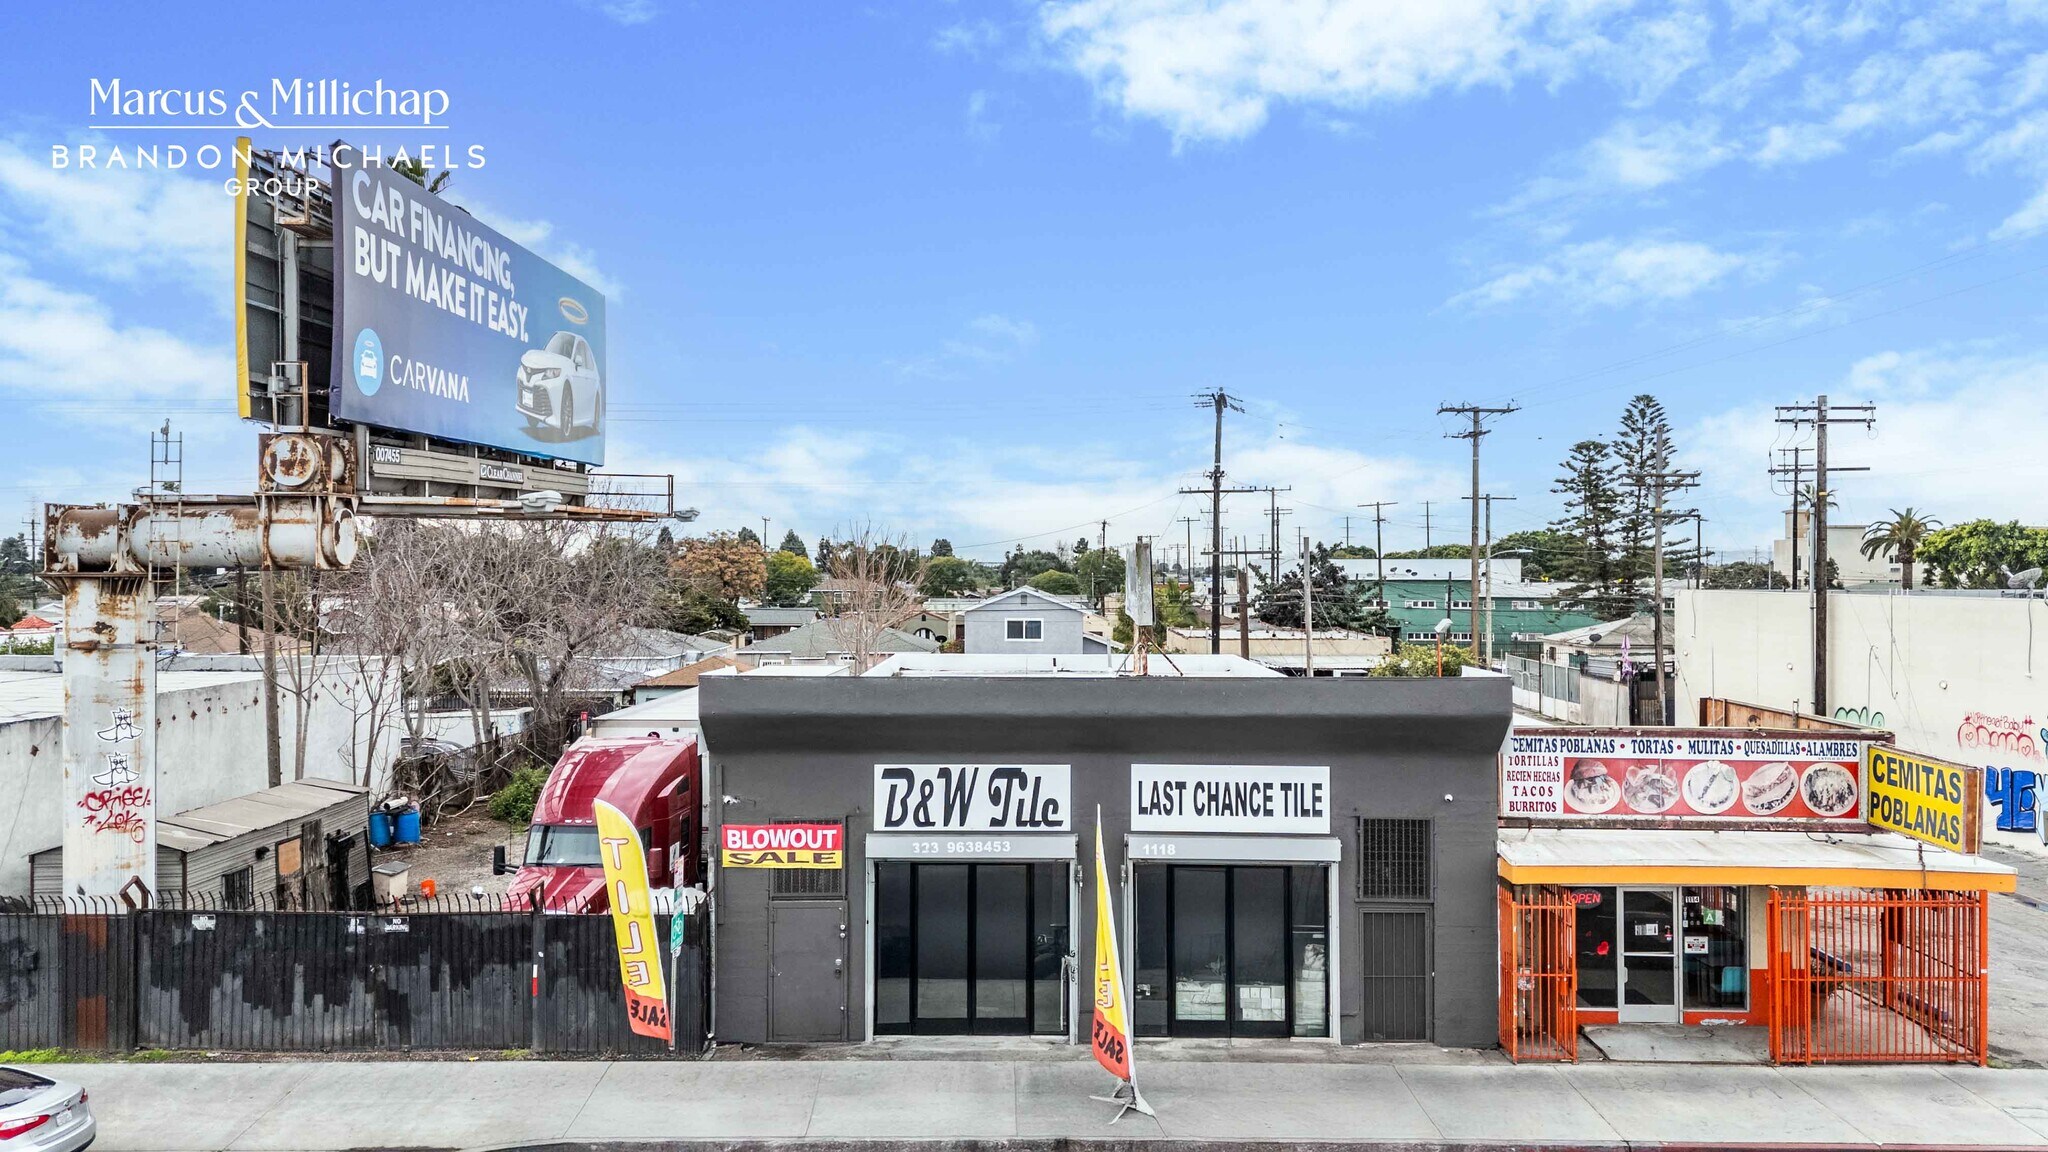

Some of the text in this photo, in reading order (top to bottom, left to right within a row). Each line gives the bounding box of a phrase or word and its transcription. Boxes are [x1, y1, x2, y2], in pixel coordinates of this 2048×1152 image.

[352, 169, 515, 299] CAR FINANCING,
[354, 225, 529, 343] BUT MAKE IT EASY.
[390, 354, 470, 403] CARVANA
[375, 446, 400, 464] 007455
[1511, 737, 1616, 754] CEMITAS POBLANAS
[1631, 739, 1674, 755] TORTAS
[1688, 739, 1735, 756] MULITAS
[1806, 741, 1858, 758] ALAMBRES
[1509, 755, 1560, 768] TORTILLAS
[1507, 770, 1561, 783] RECIEN HECHAS
[1872, 753, 1962, 805] CEMITAS
[881, 766, 1065, 829] B&W Tile
[1138, 780, 1323, 818] LAST CHANCE TILE
[1513, 785, 1554, 798] TACOS
[1509, 801, 1557, 813] BURRITOS
[1869, 791, 1961, 845] POBLANAS
[726, 828, 837, 850] BLOWOUT
[912, 841, 1012, 854] 323 9638453
[728, 851, 837, 865] SALE
[1142, 843, 1176, 856] 1118
[1570, 893, 1601, 904] OPEN
[1706, 913, 1714, 922] A
